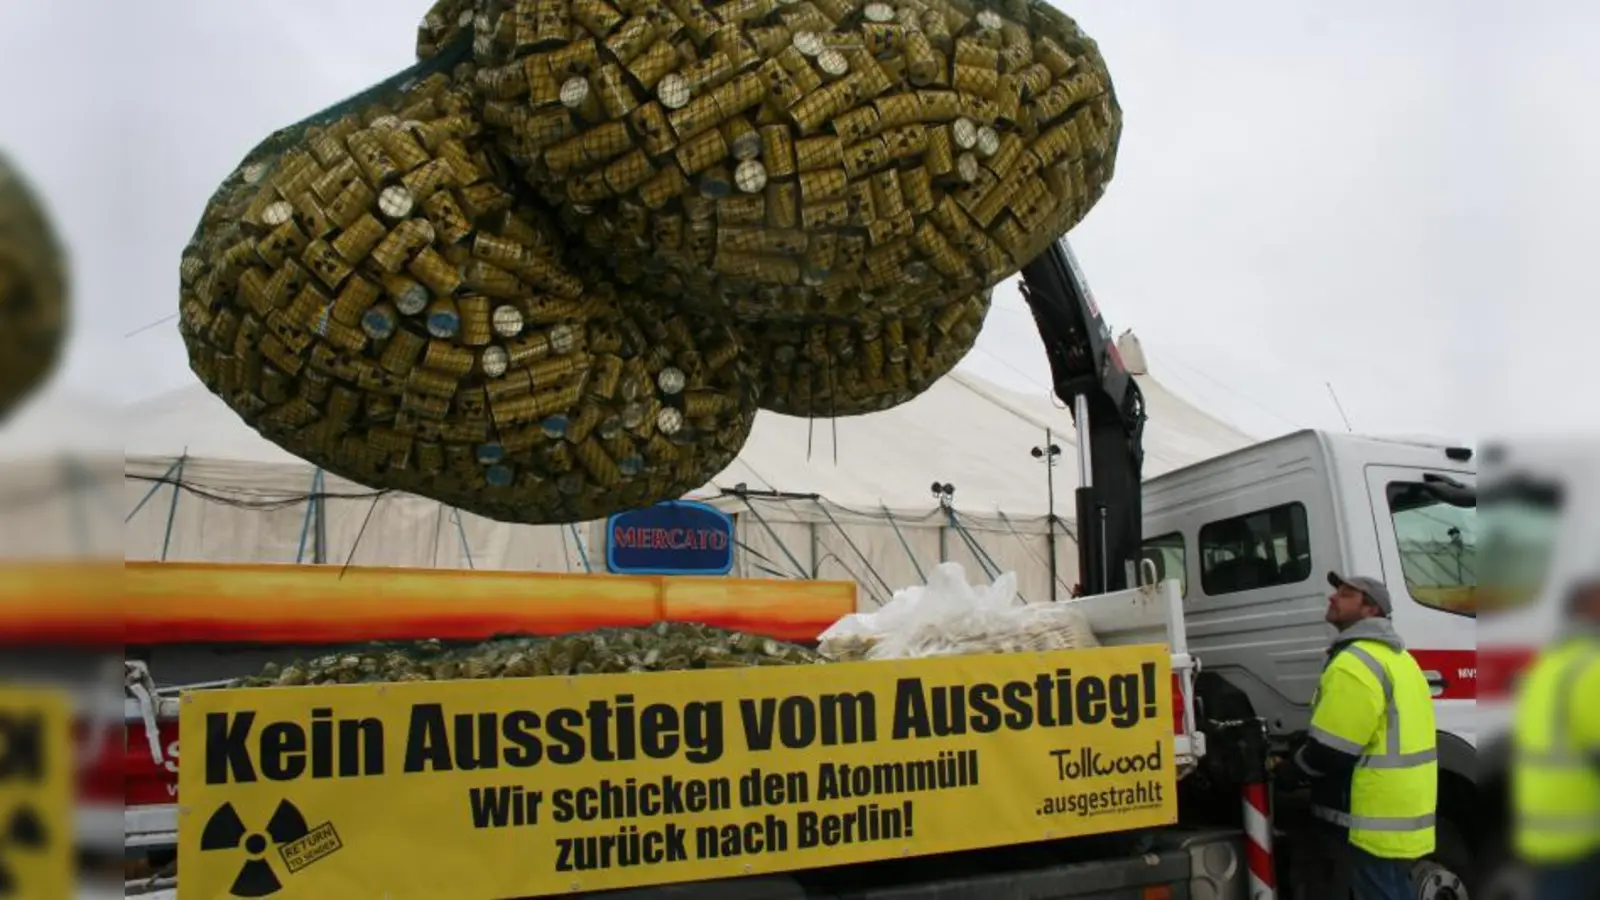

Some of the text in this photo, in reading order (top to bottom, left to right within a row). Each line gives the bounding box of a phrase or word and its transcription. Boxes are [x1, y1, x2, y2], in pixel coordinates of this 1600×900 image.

[614, 525, 728, 550] MERCATO
[205, 707, 385, 786] Kein
[403, 694, 724, 774] Ausstieg
[739, 691, 877, 752] vom
[892, 662, 1157, 741] Ausstieg!
[469, 749, 979, 829] Wir schicken den Atommüll
[284, 828, 333, 858] RETURN
[555, 801, 914, 873] zurück nach Berlin!
